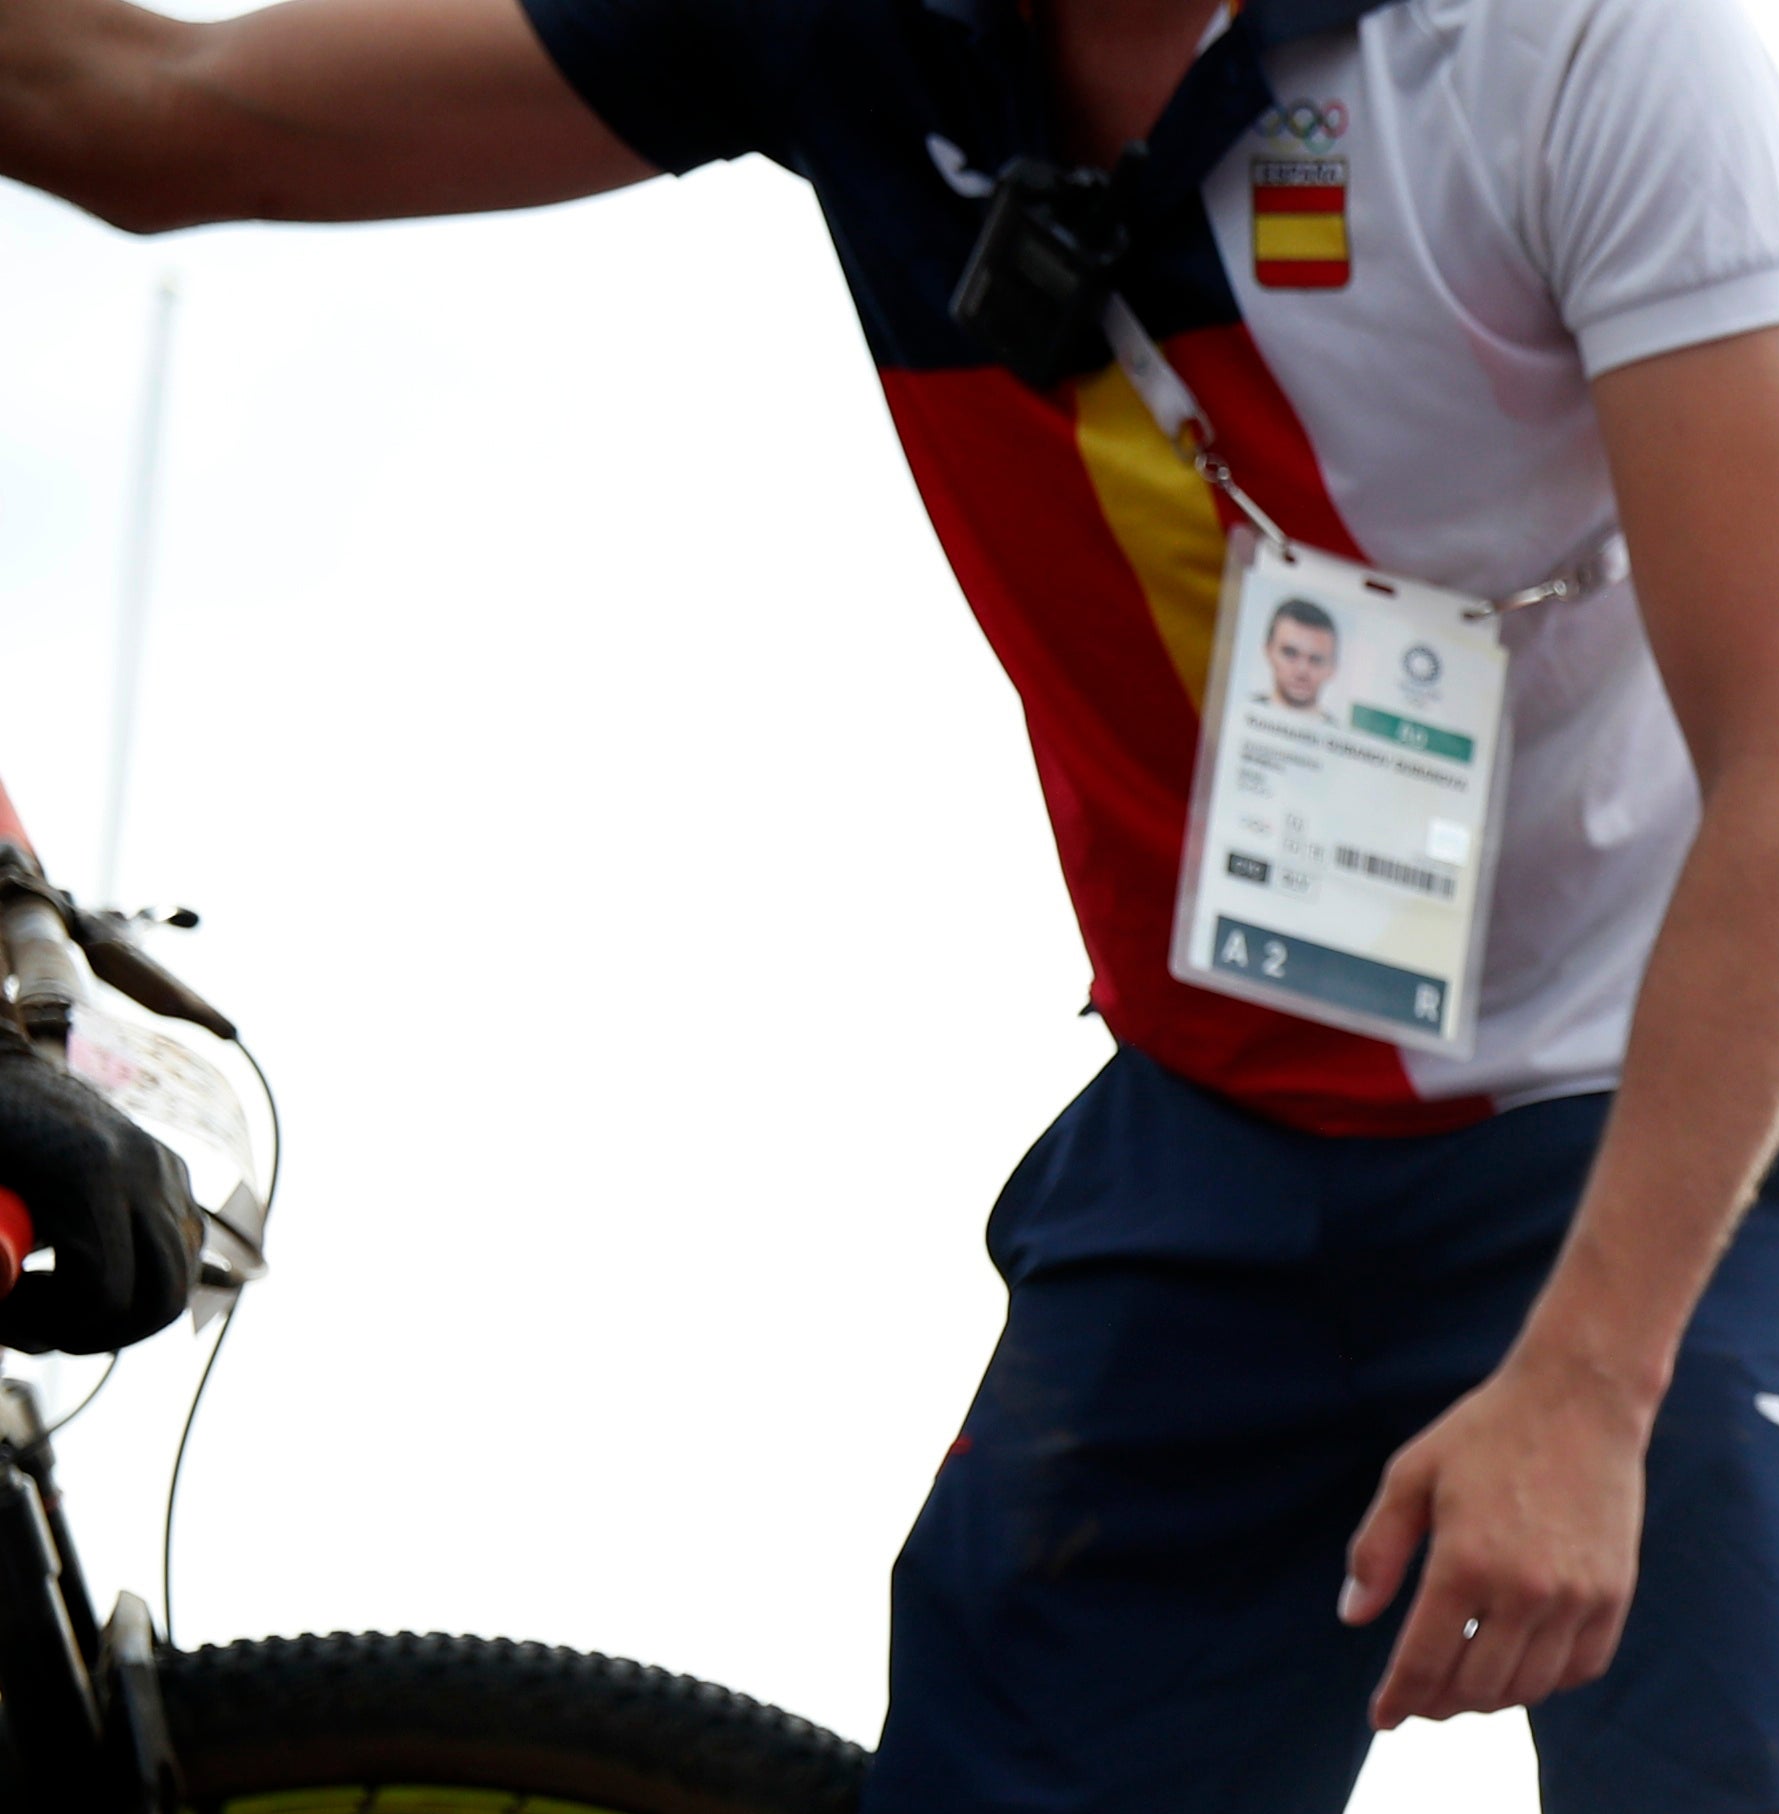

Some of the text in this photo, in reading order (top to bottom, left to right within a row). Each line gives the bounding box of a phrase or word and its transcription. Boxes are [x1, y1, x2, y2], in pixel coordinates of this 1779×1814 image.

[1221, 929, 1442, 1021] A 2 R
